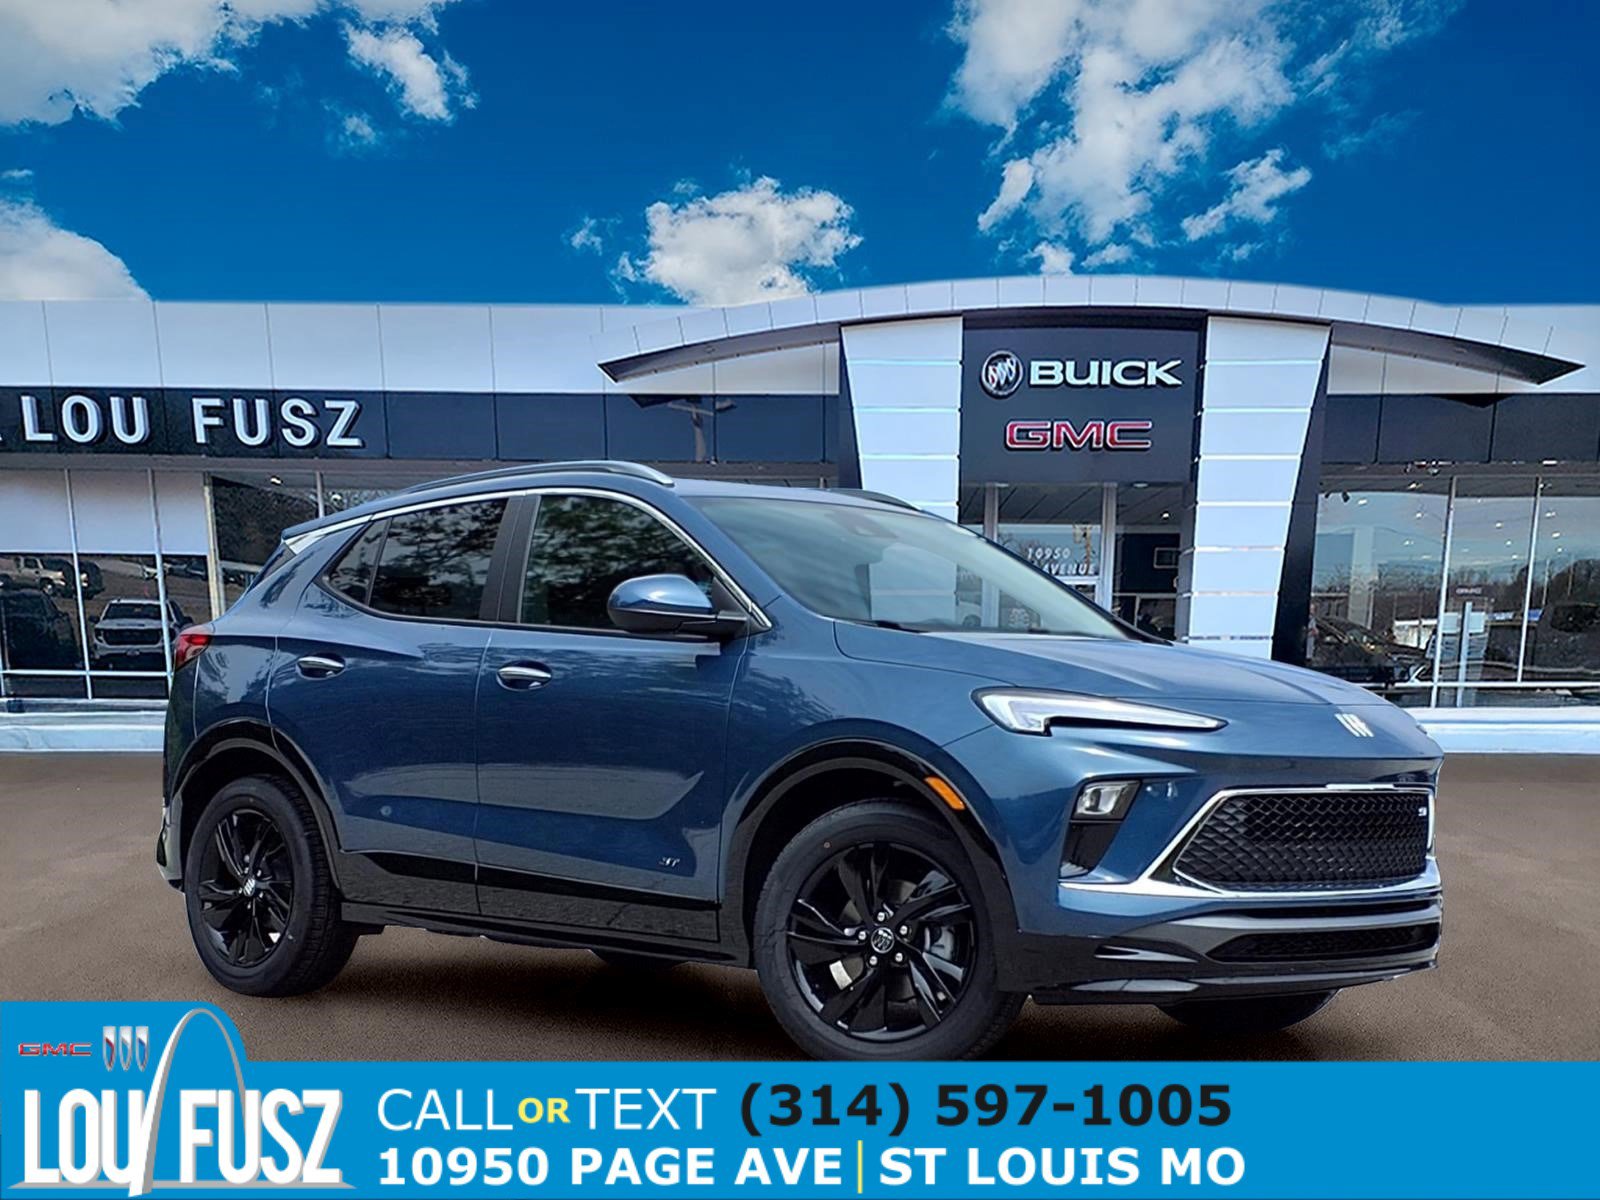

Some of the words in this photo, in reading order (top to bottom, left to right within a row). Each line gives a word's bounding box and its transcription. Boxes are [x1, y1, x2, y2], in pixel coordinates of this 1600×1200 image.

[1030, 360, 1183, 386] BUICK
[20, 395, 150, 444] LOU
[192, 397, 363, 447] FUSZ
[1006, 420, 1153, 449] GMC
[1027, 547, 1071, 560] 10950
